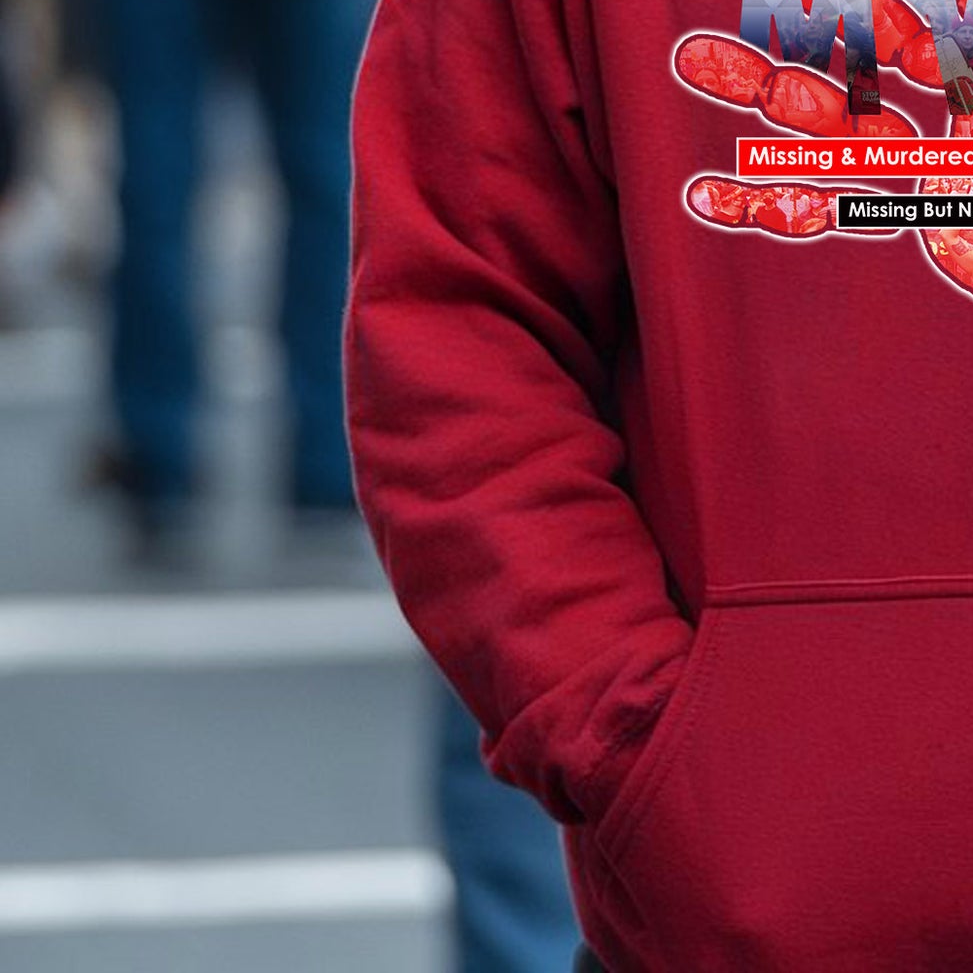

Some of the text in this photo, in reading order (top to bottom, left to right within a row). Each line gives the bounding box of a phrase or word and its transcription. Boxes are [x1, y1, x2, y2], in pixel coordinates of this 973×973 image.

[748, 145, 833, 170] Missing
[841, 147, 857, 166] &
[848, 201, 917, 222] Missing
[924, 201, 953, 218] But
